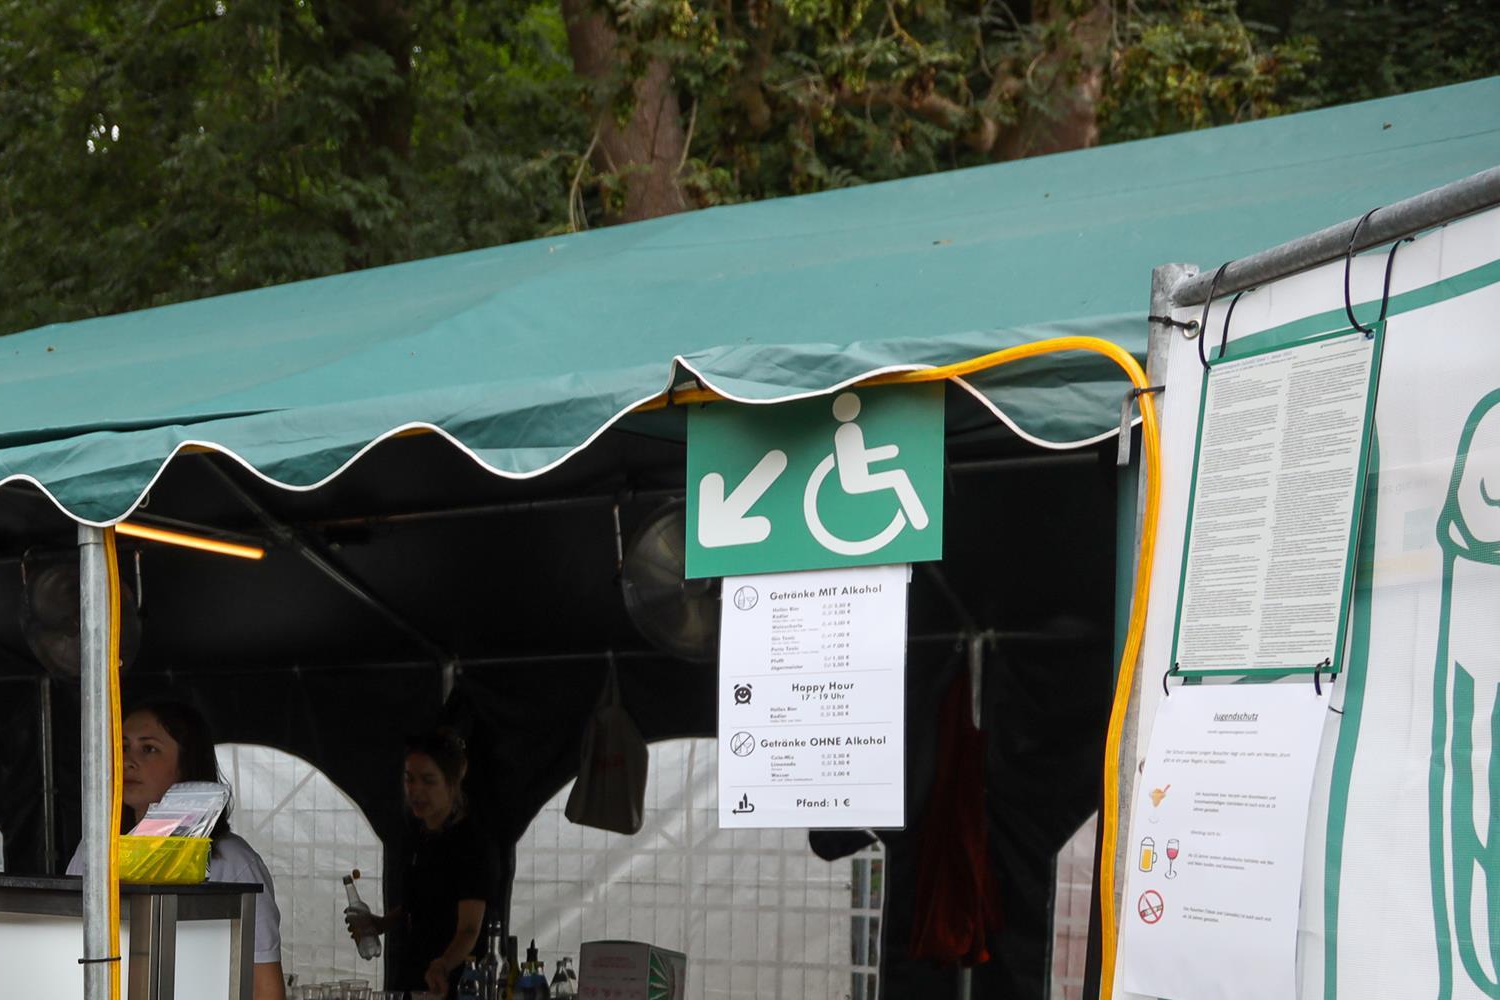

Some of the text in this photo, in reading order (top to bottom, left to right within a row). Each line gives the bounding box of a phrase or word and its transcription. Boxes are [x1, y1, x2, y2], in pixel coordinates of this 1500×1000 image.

[770, 584, 882, 601] Getränke MIT Alkohol
[791, 681, 854, 693] Happy Hour
[801, 693, 810, 701] 17
[831, 692, 845, 700] Uhr
[1213, 712, 1259, 722] Jugendschutz
[760, 735, 886, 748] Getränke OHNE Alkohol
[796, 798, 830, 807] Pfand:
